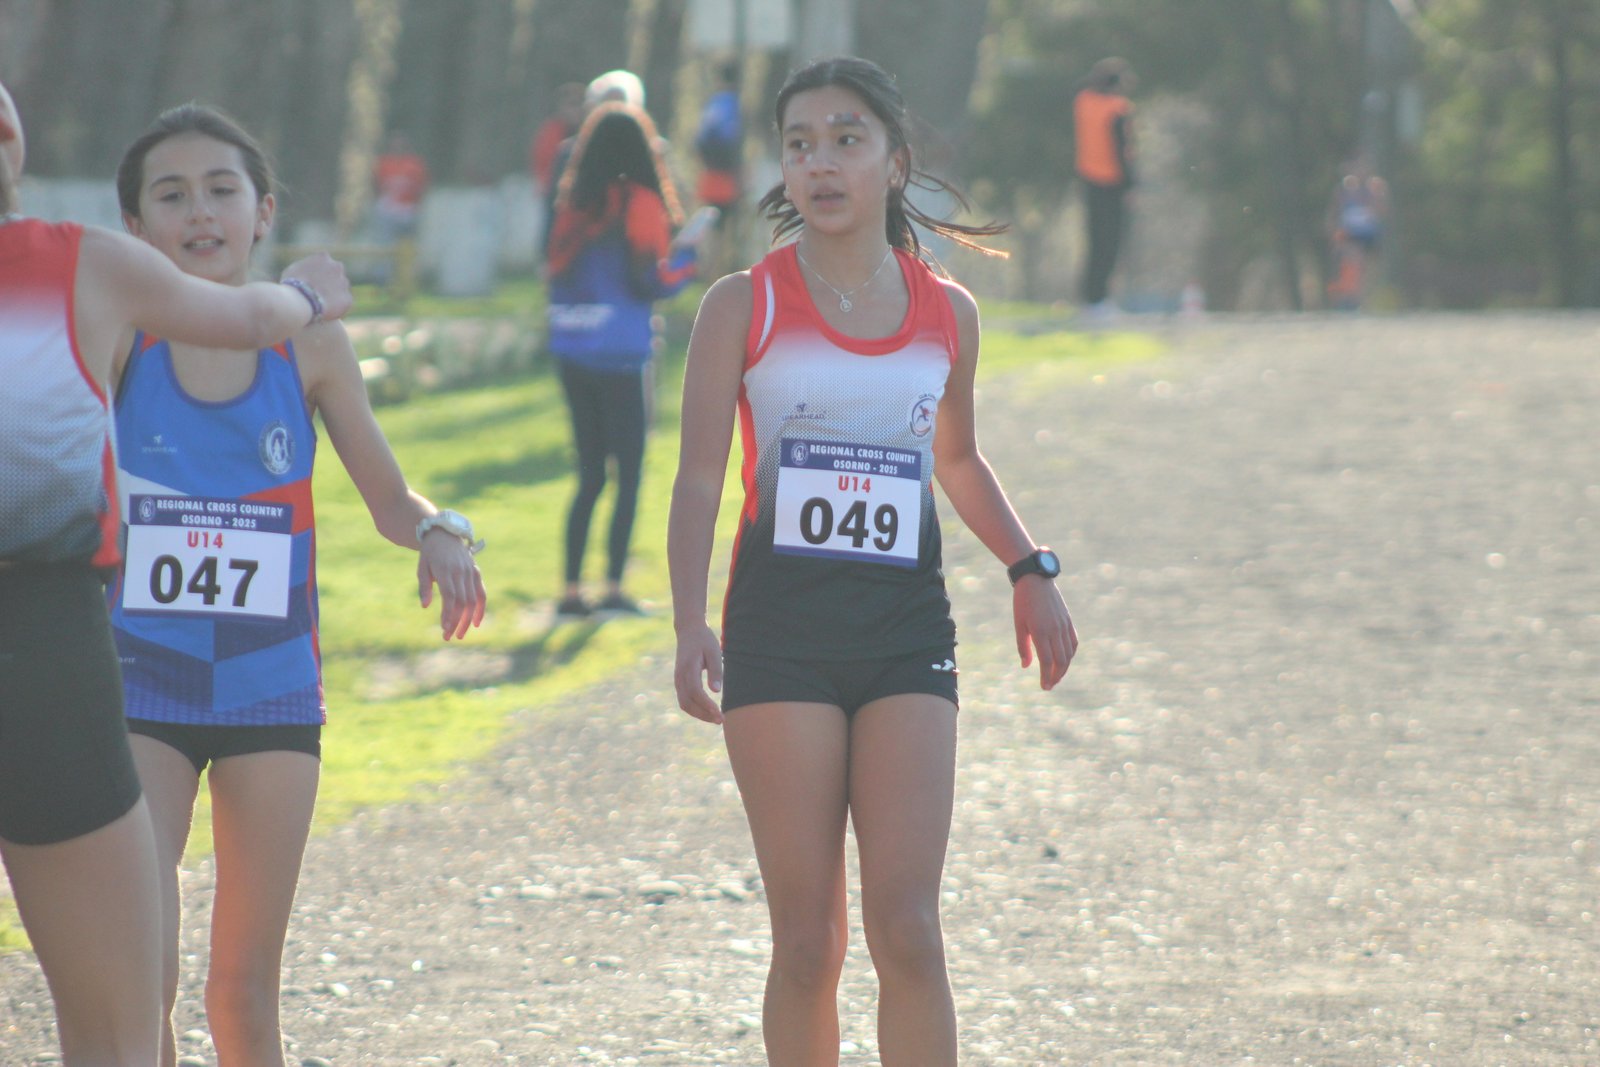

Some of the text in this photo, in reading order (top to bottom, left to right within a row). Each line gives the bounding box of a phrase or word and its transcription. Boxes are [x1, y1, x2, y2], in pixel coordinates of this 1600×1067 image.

[810, 444, 916, 464] REGIONAL CROSS COUNTRY
[833, 459, 871, 472] OSORNO
[879, 464, 898, 475] 2025
[838, 475, 872, 493] U14
[157, 499, 283, 517] REGIONAL CROSS COUNTRY
[181, 514, 222, 526] OSORNO
[232, 517, 256, 528] 2025
[799, 496, 899, 552] 049
[187, 530, 224, 549] U14
[149, 553, 259, 608] 047
